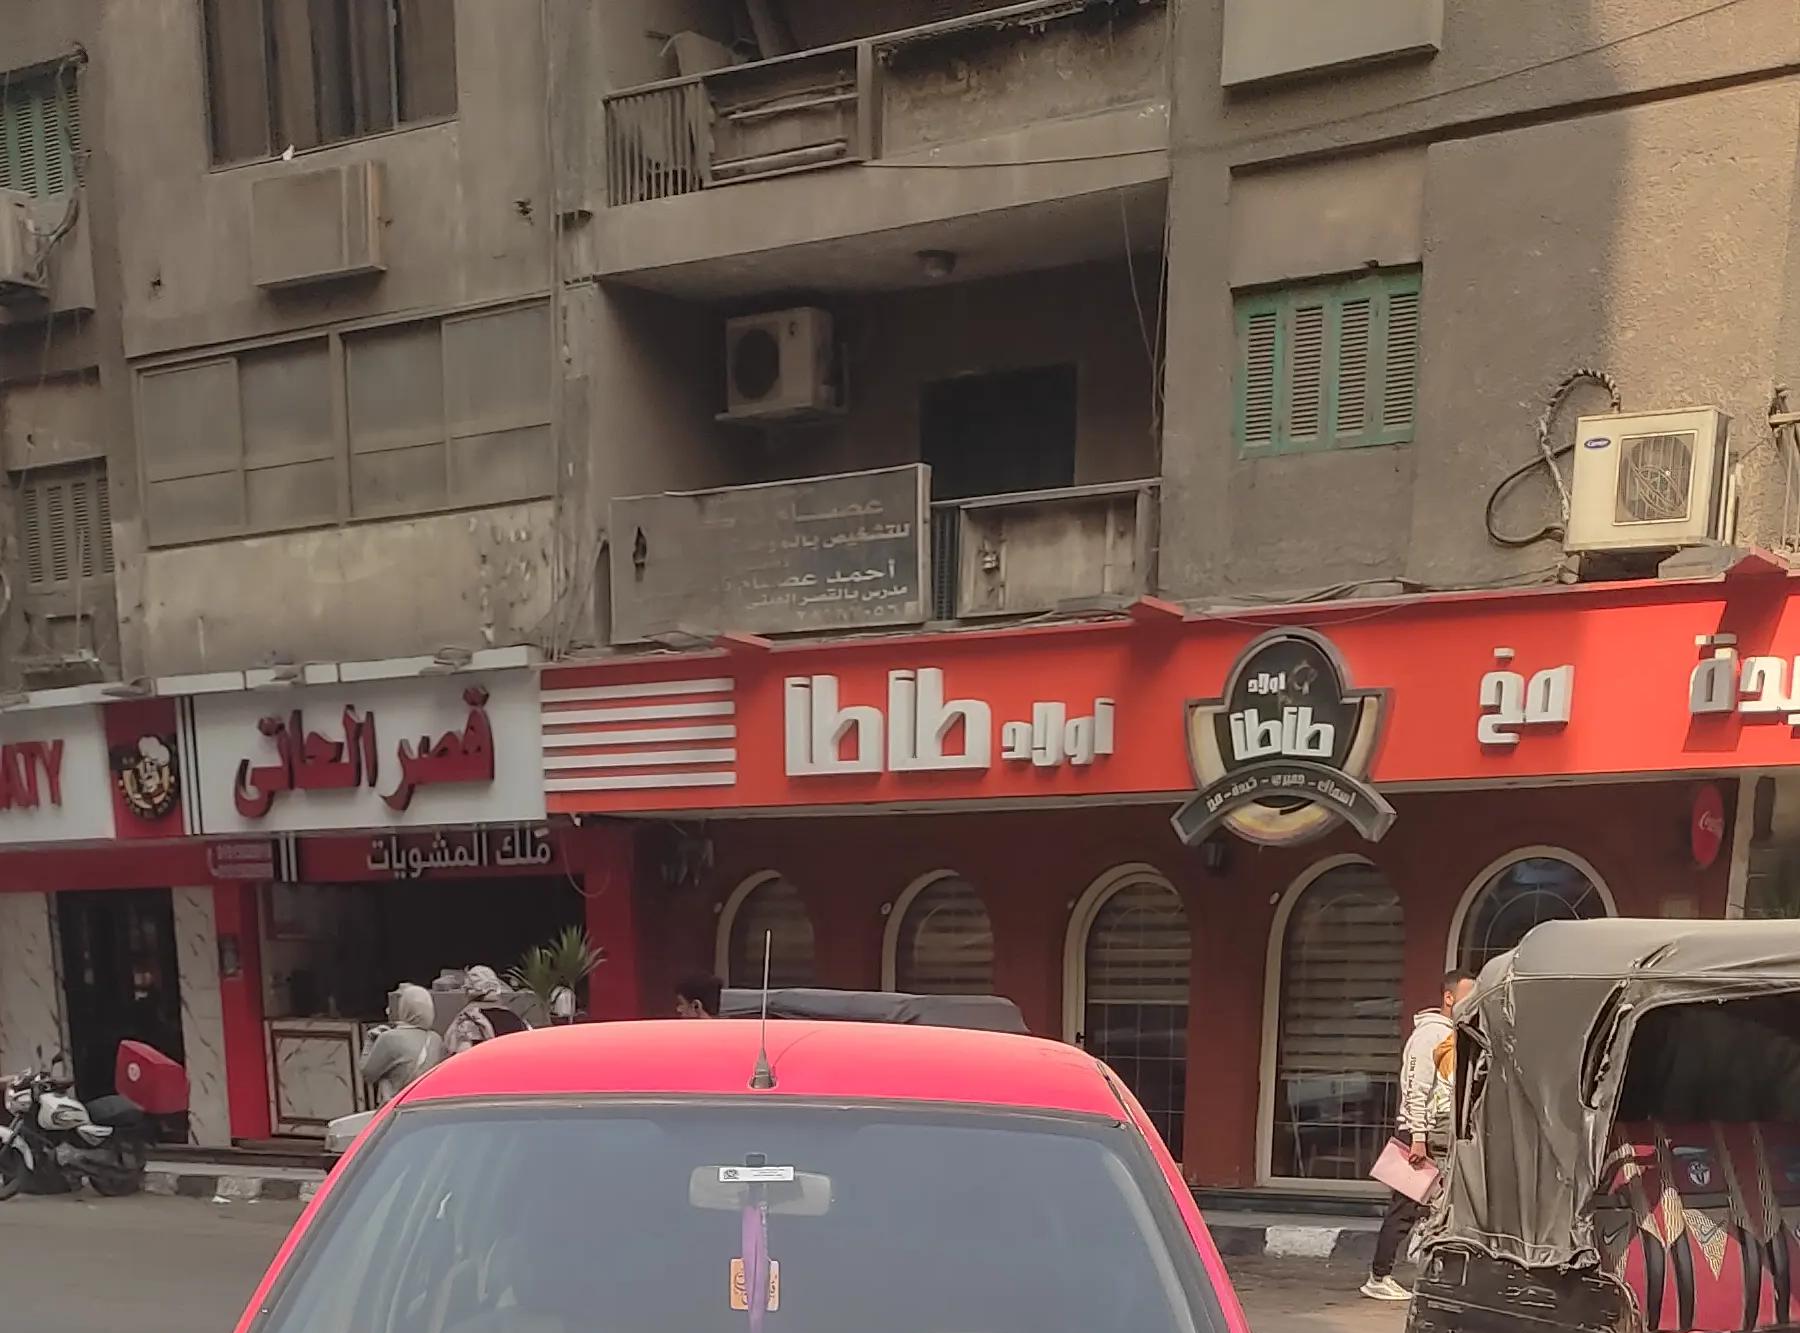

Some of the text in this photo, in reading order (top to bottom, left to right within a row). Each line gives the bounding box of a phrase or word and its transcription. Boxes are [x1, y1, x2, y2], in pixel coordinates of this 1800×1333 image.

[1477, 647, 1575, 745] مخ
[379, 685, 495, 812] قصر
[366, 821, 488, 880] المشويات
